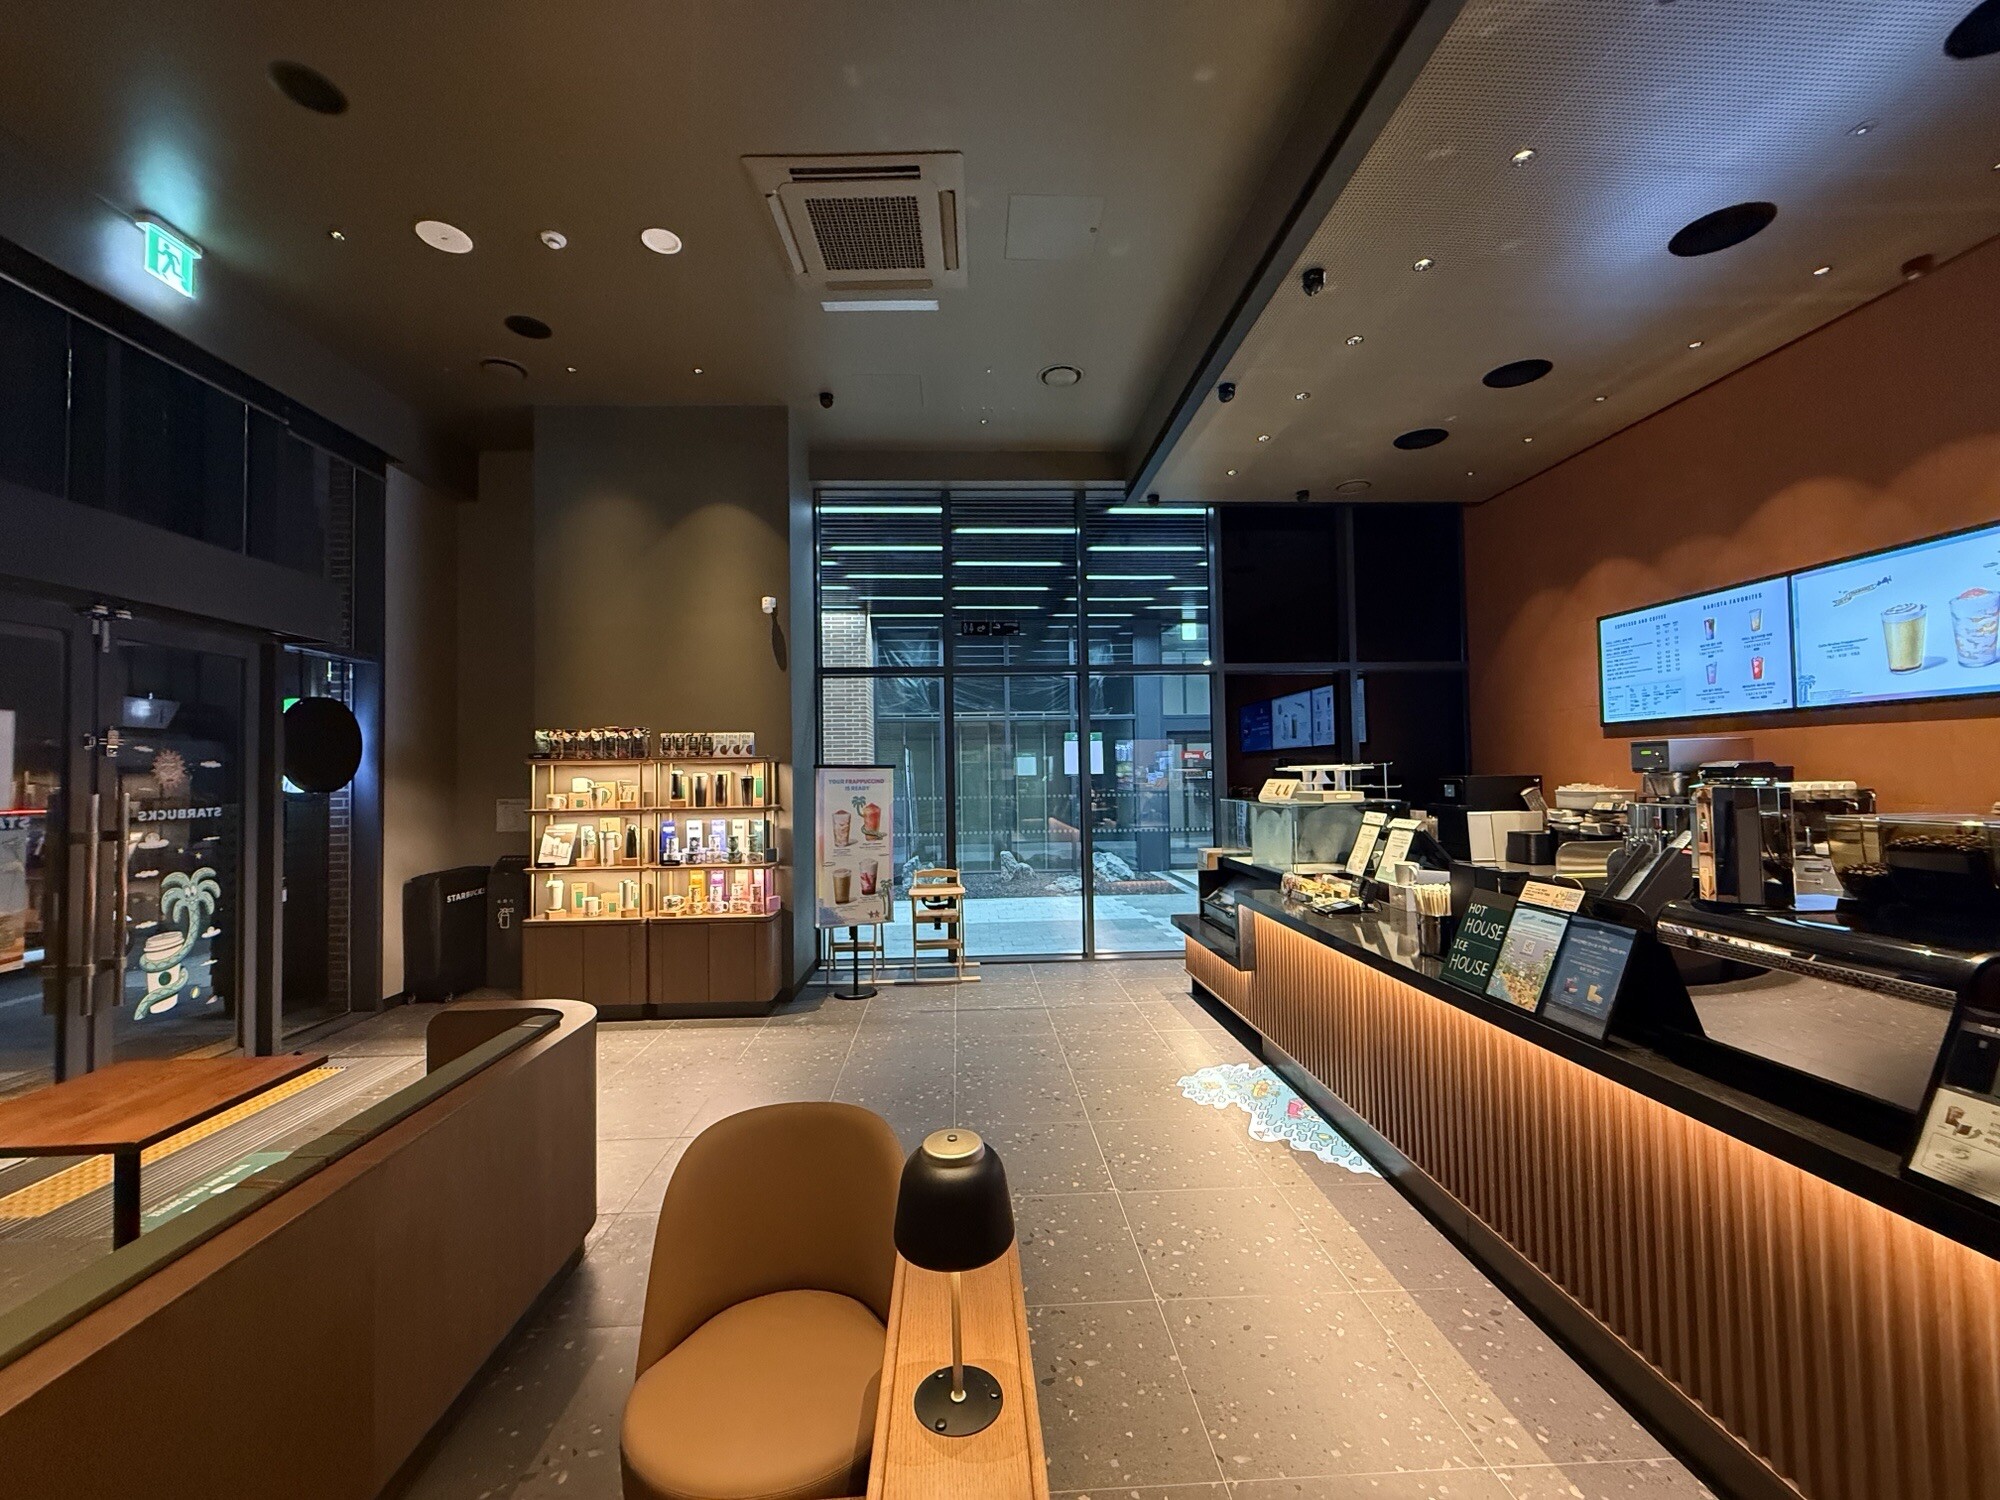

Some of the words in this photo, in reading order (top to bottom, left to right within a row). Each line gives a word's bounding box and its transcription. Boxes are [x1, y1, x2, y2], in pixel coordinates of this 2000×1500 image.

[1703, 600, 1727, 610] BARISTA
[1729, 592, 1762, 604] FAVORITES
[1468, 903, 1488, 917] HOT
[1464, 918, 1505, 940] HOUSE
[1453, 938, 1469, 951] ICE
[1448, 953, 1490, 977] HOUSE
